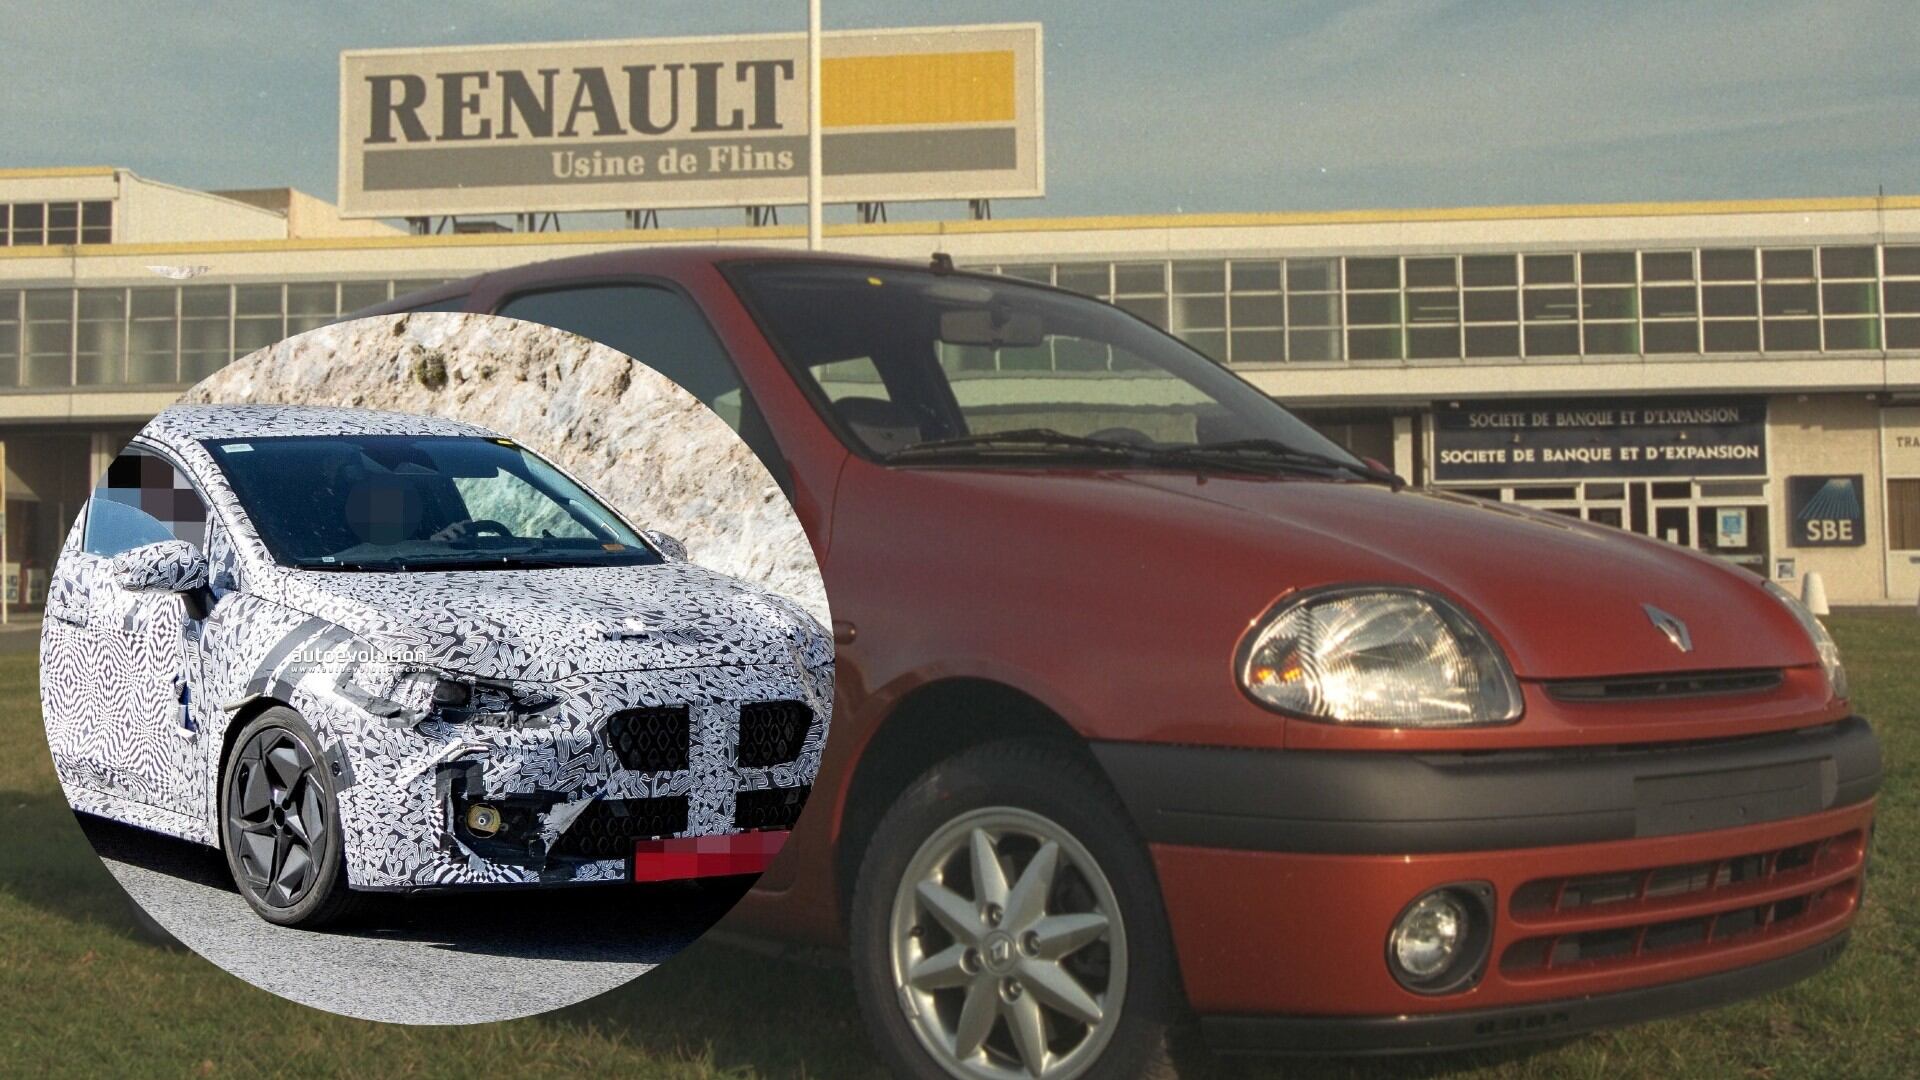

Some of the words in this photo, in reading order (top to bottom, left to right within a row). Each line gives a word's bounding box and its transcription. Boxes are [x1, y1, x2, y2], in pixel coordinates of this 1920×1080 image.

[364, 59, 794, 144] RENAULT
[551, 149, 645, 180] Usine
[657, 146, 698, 175] de
[708, 143, 795, 174] Flins
[1440, 450, 1506, 464] SOCIETE
[1513, 449, 1535, 462] DE
[1543, 448, 1612, 464] BANQUE
[1620, 447, 1640, 461] ET
[1646, 445, 1759, 460] D'EXPANSION
[1807, 519, 1853, 541] SBE
